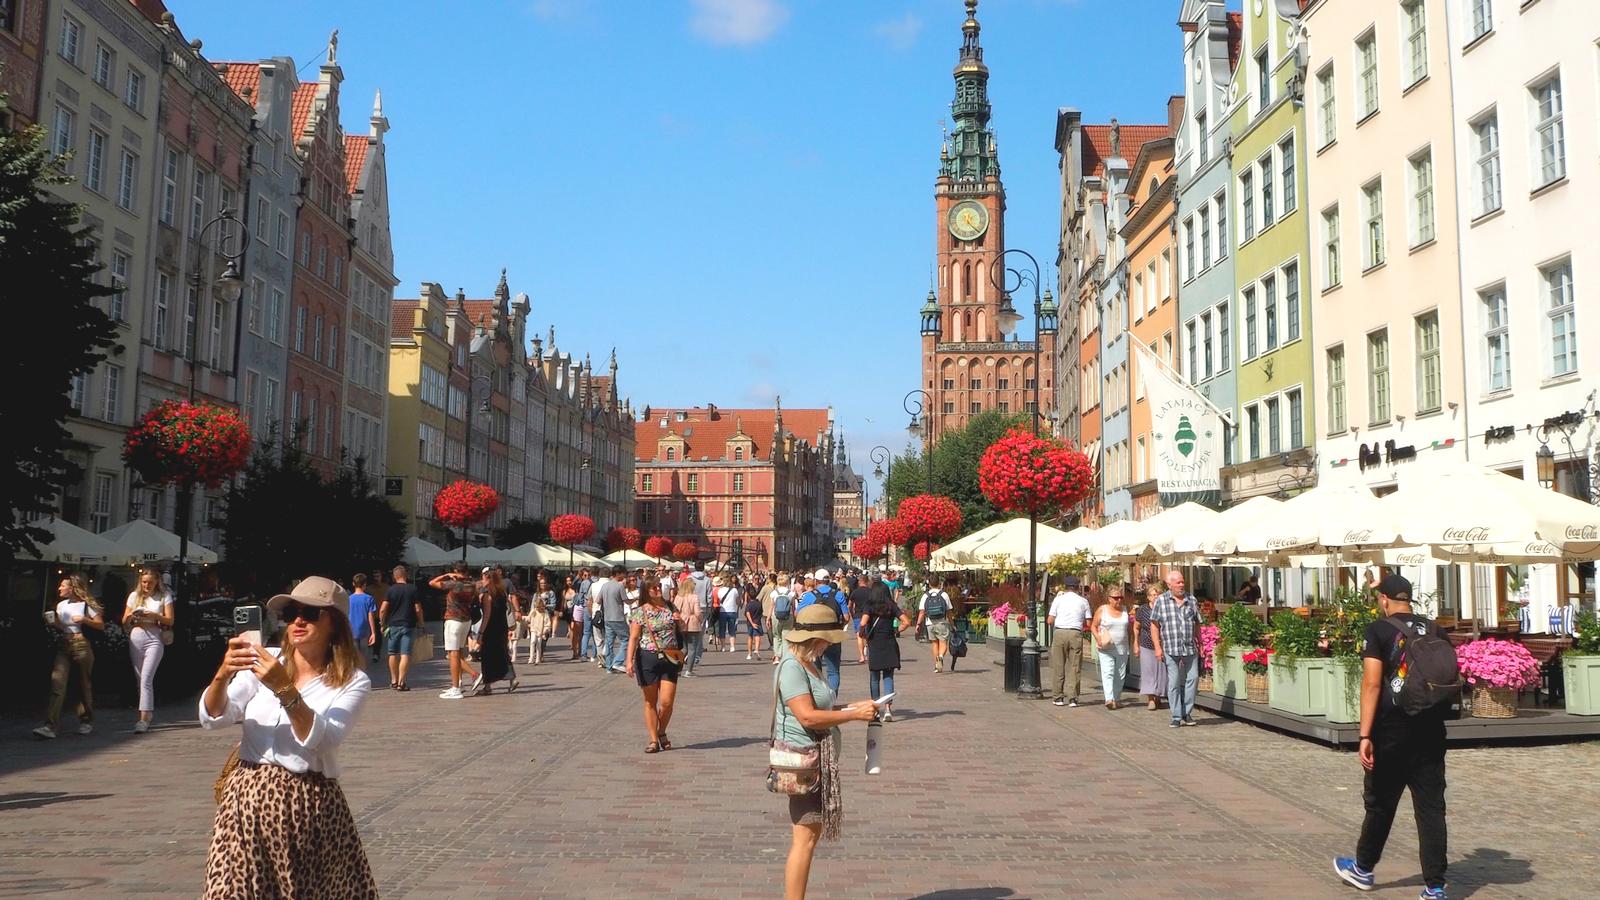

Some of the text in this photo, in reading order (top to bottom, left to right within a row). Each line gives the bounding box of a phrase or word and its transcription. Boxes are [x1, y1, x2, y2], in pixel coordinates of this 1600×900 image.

[1160, 449, 1212, 473] HOLENDER
[1160, 478, 1217, 488] RESTAURACJA
[1442, 526, 1490, 541] Coca-Cola
